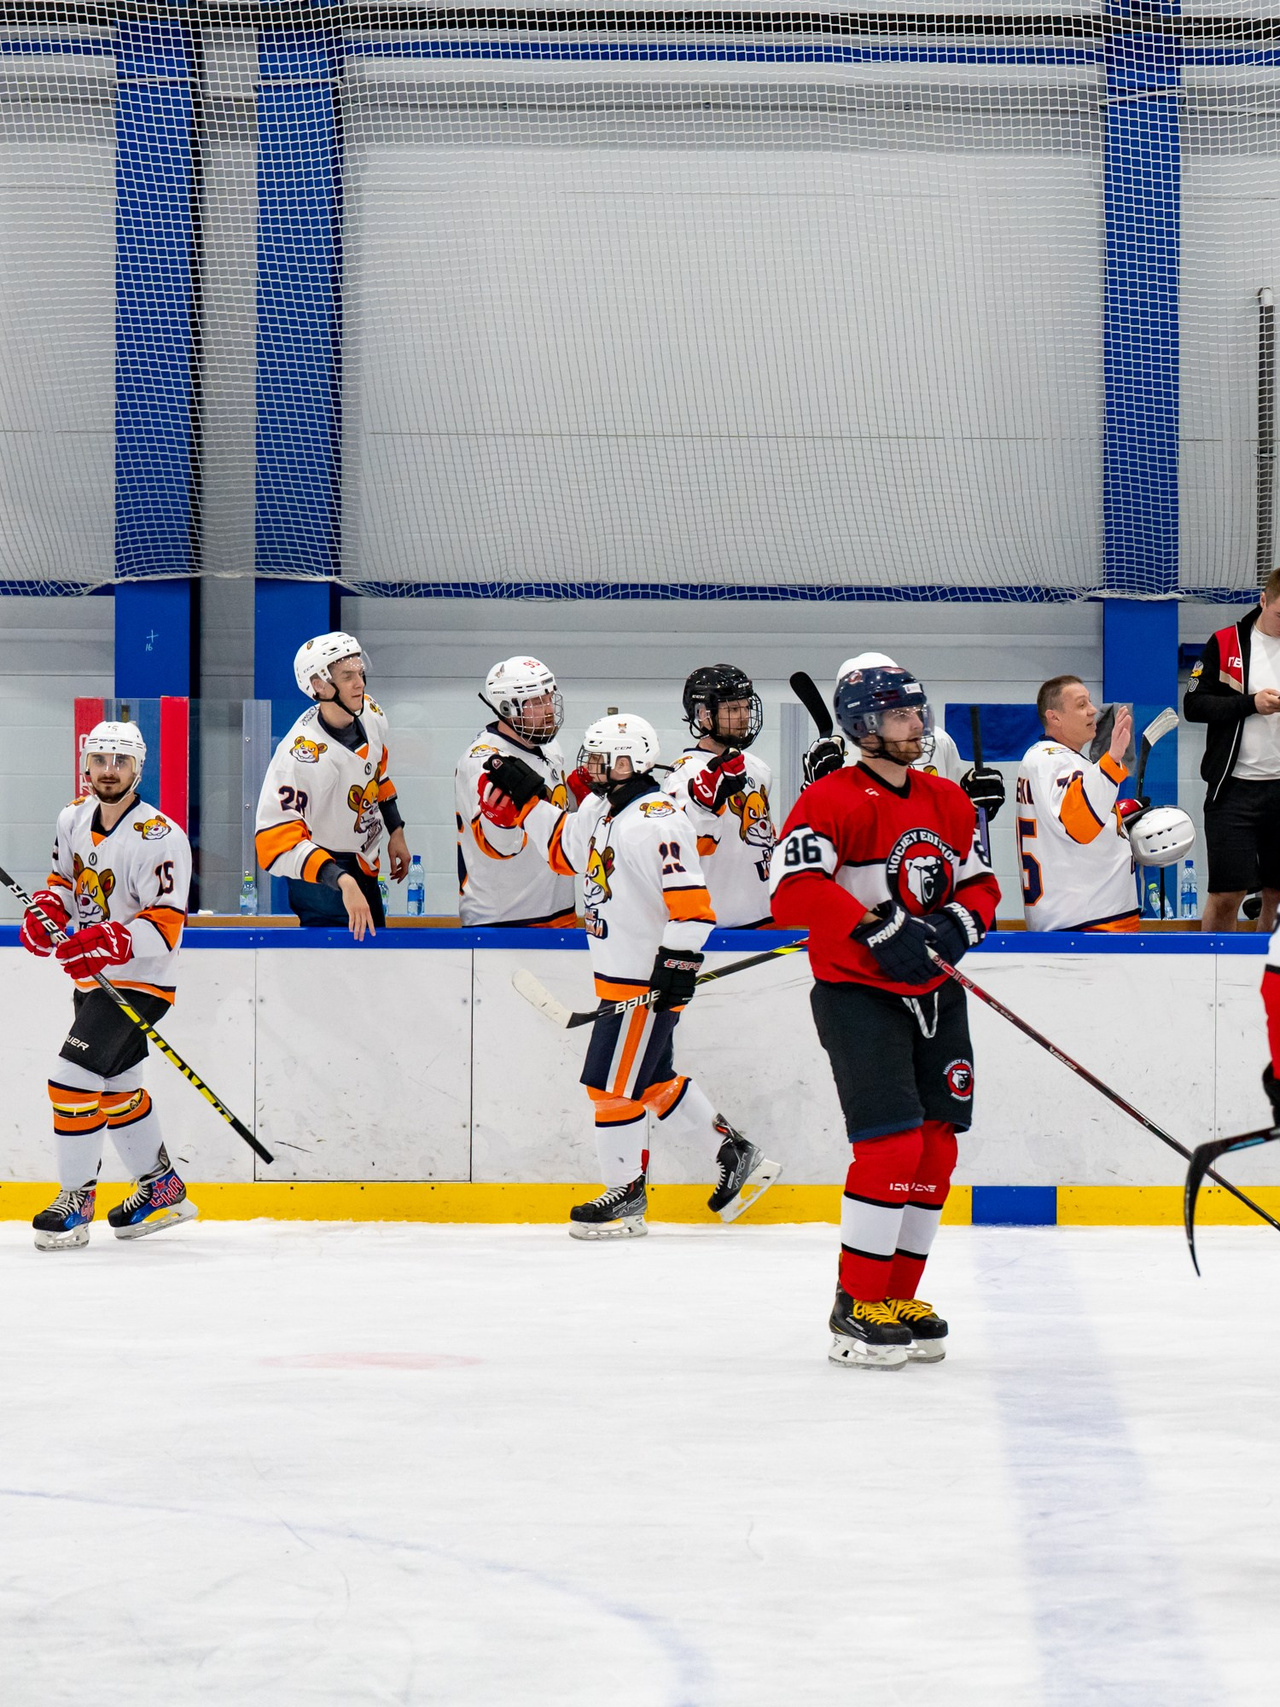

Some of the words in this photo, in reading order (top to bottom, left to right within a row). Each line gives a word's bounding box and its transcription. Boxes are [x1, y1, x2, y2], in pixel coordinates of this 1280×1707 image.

[784, 834, 822, 867] 86
[1017, 816, 1044, 906] 5
[154, 860, 175, 897] 15
[8, 884, 70, 944] BAUER
[944, 902, 980, 946] PRIME
[614, 989, 662, 1015] BAUE
